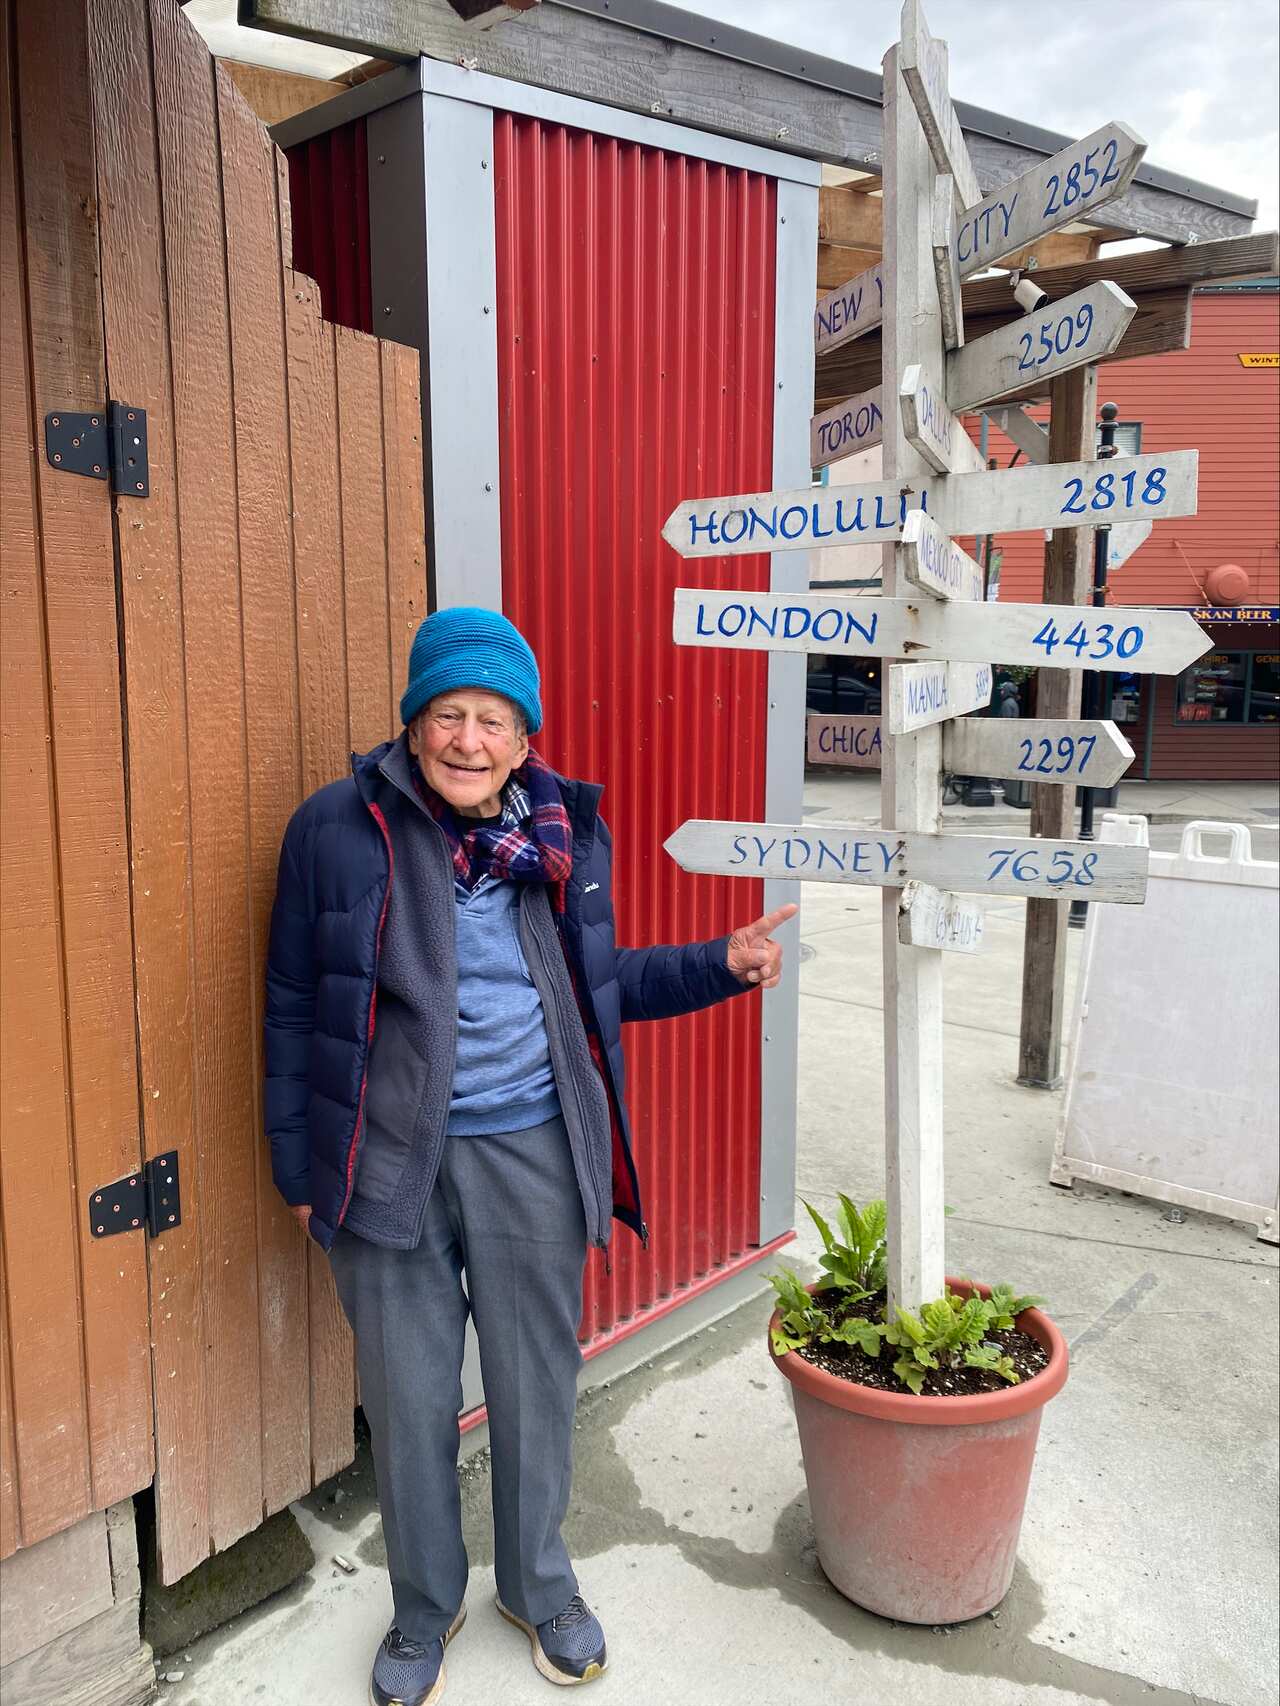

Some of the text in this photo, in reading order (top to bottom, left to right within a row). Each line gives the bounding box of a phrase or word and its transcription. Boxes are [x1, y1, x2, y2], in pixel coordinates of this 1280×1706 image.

[957, 139, 1119, 262] CITY 2852
[818, 287, 863, 340] NEW
[1018, 303, 1093, 370] 2509
[921, 386, 951, 456] DALLAS
[689, 466, 1168, 545] HONOLULU 2818
[695, 603, 1145, 660] LONDON 4430
[1237, 610, 1272, 620] BEER
[908, 672, 948, 715] MANILA
[818, 725, 882, 756] CHICA
[1018, 735, 1098, 774] 2297
[728, 835, 1099, 886] SYDNEY 7658
